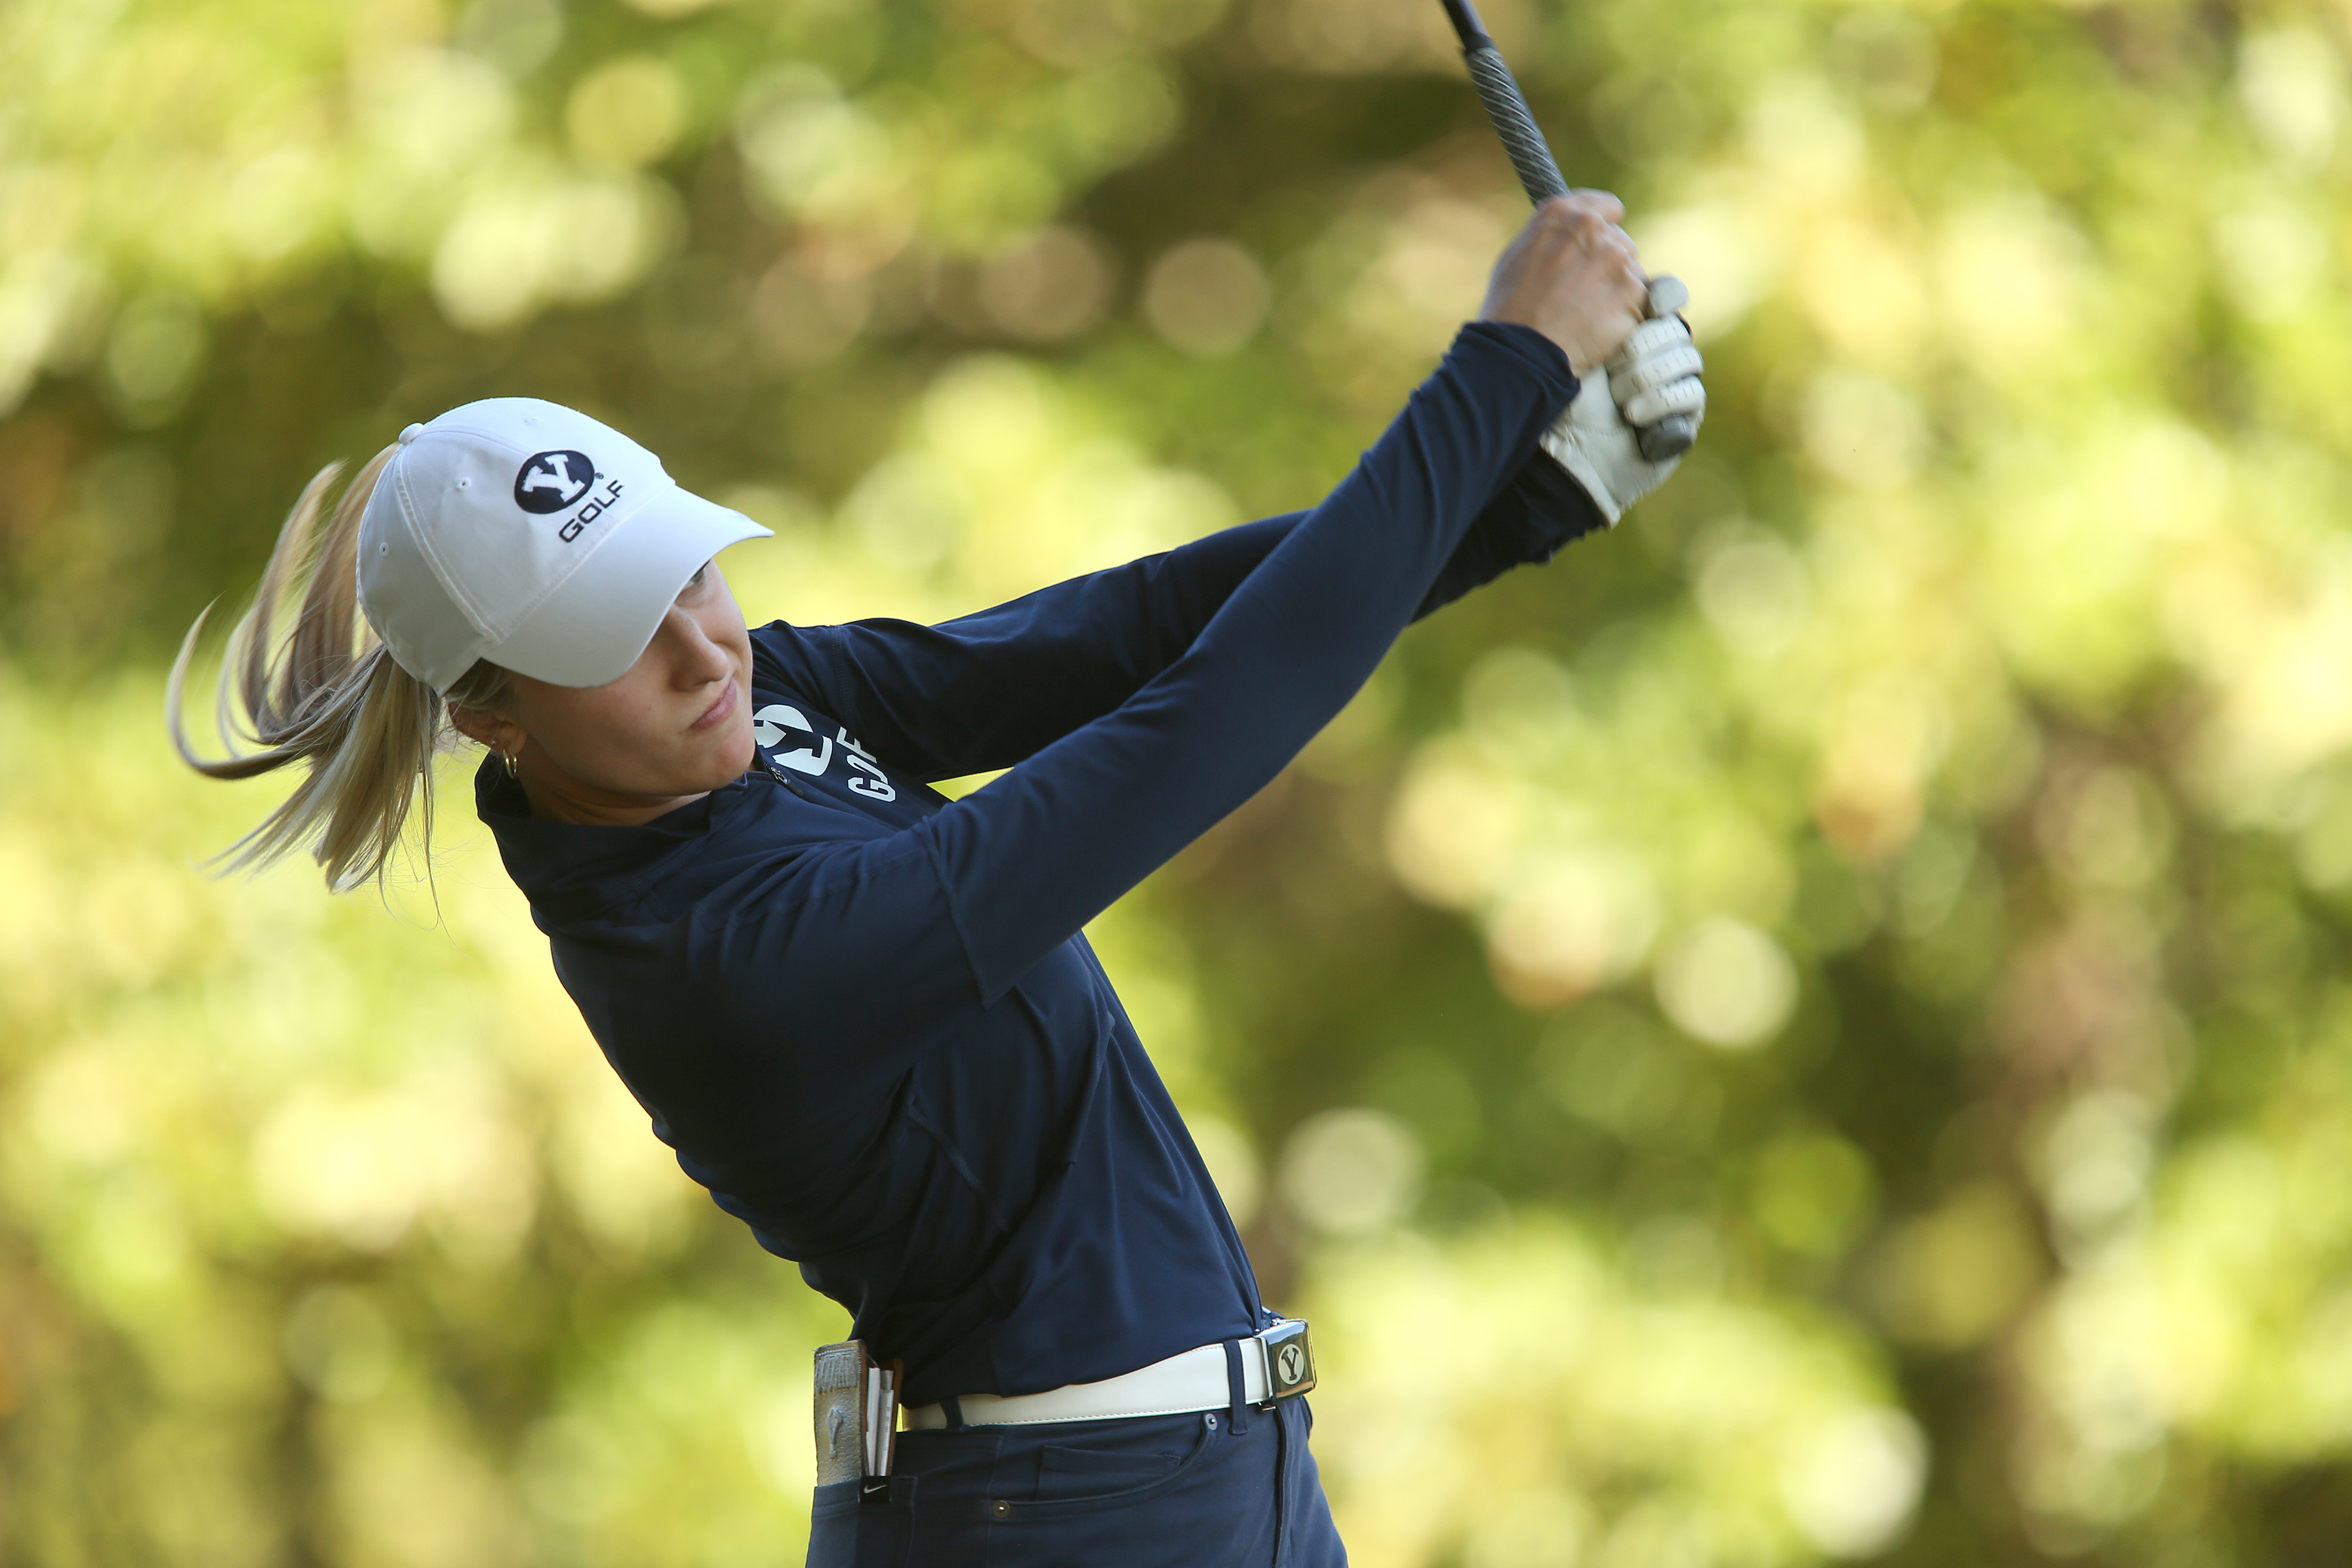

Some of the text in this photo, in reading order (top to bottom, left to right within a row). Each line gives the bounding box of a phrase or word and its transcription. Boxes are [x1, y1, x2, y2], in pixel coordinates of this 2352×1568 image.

[522, 453, 585, 502] Y
[559, 480, 624, 543] GOLF
[836, 726, 896, 802] GOF
[1281, 1347, 1299, 1381] Y
